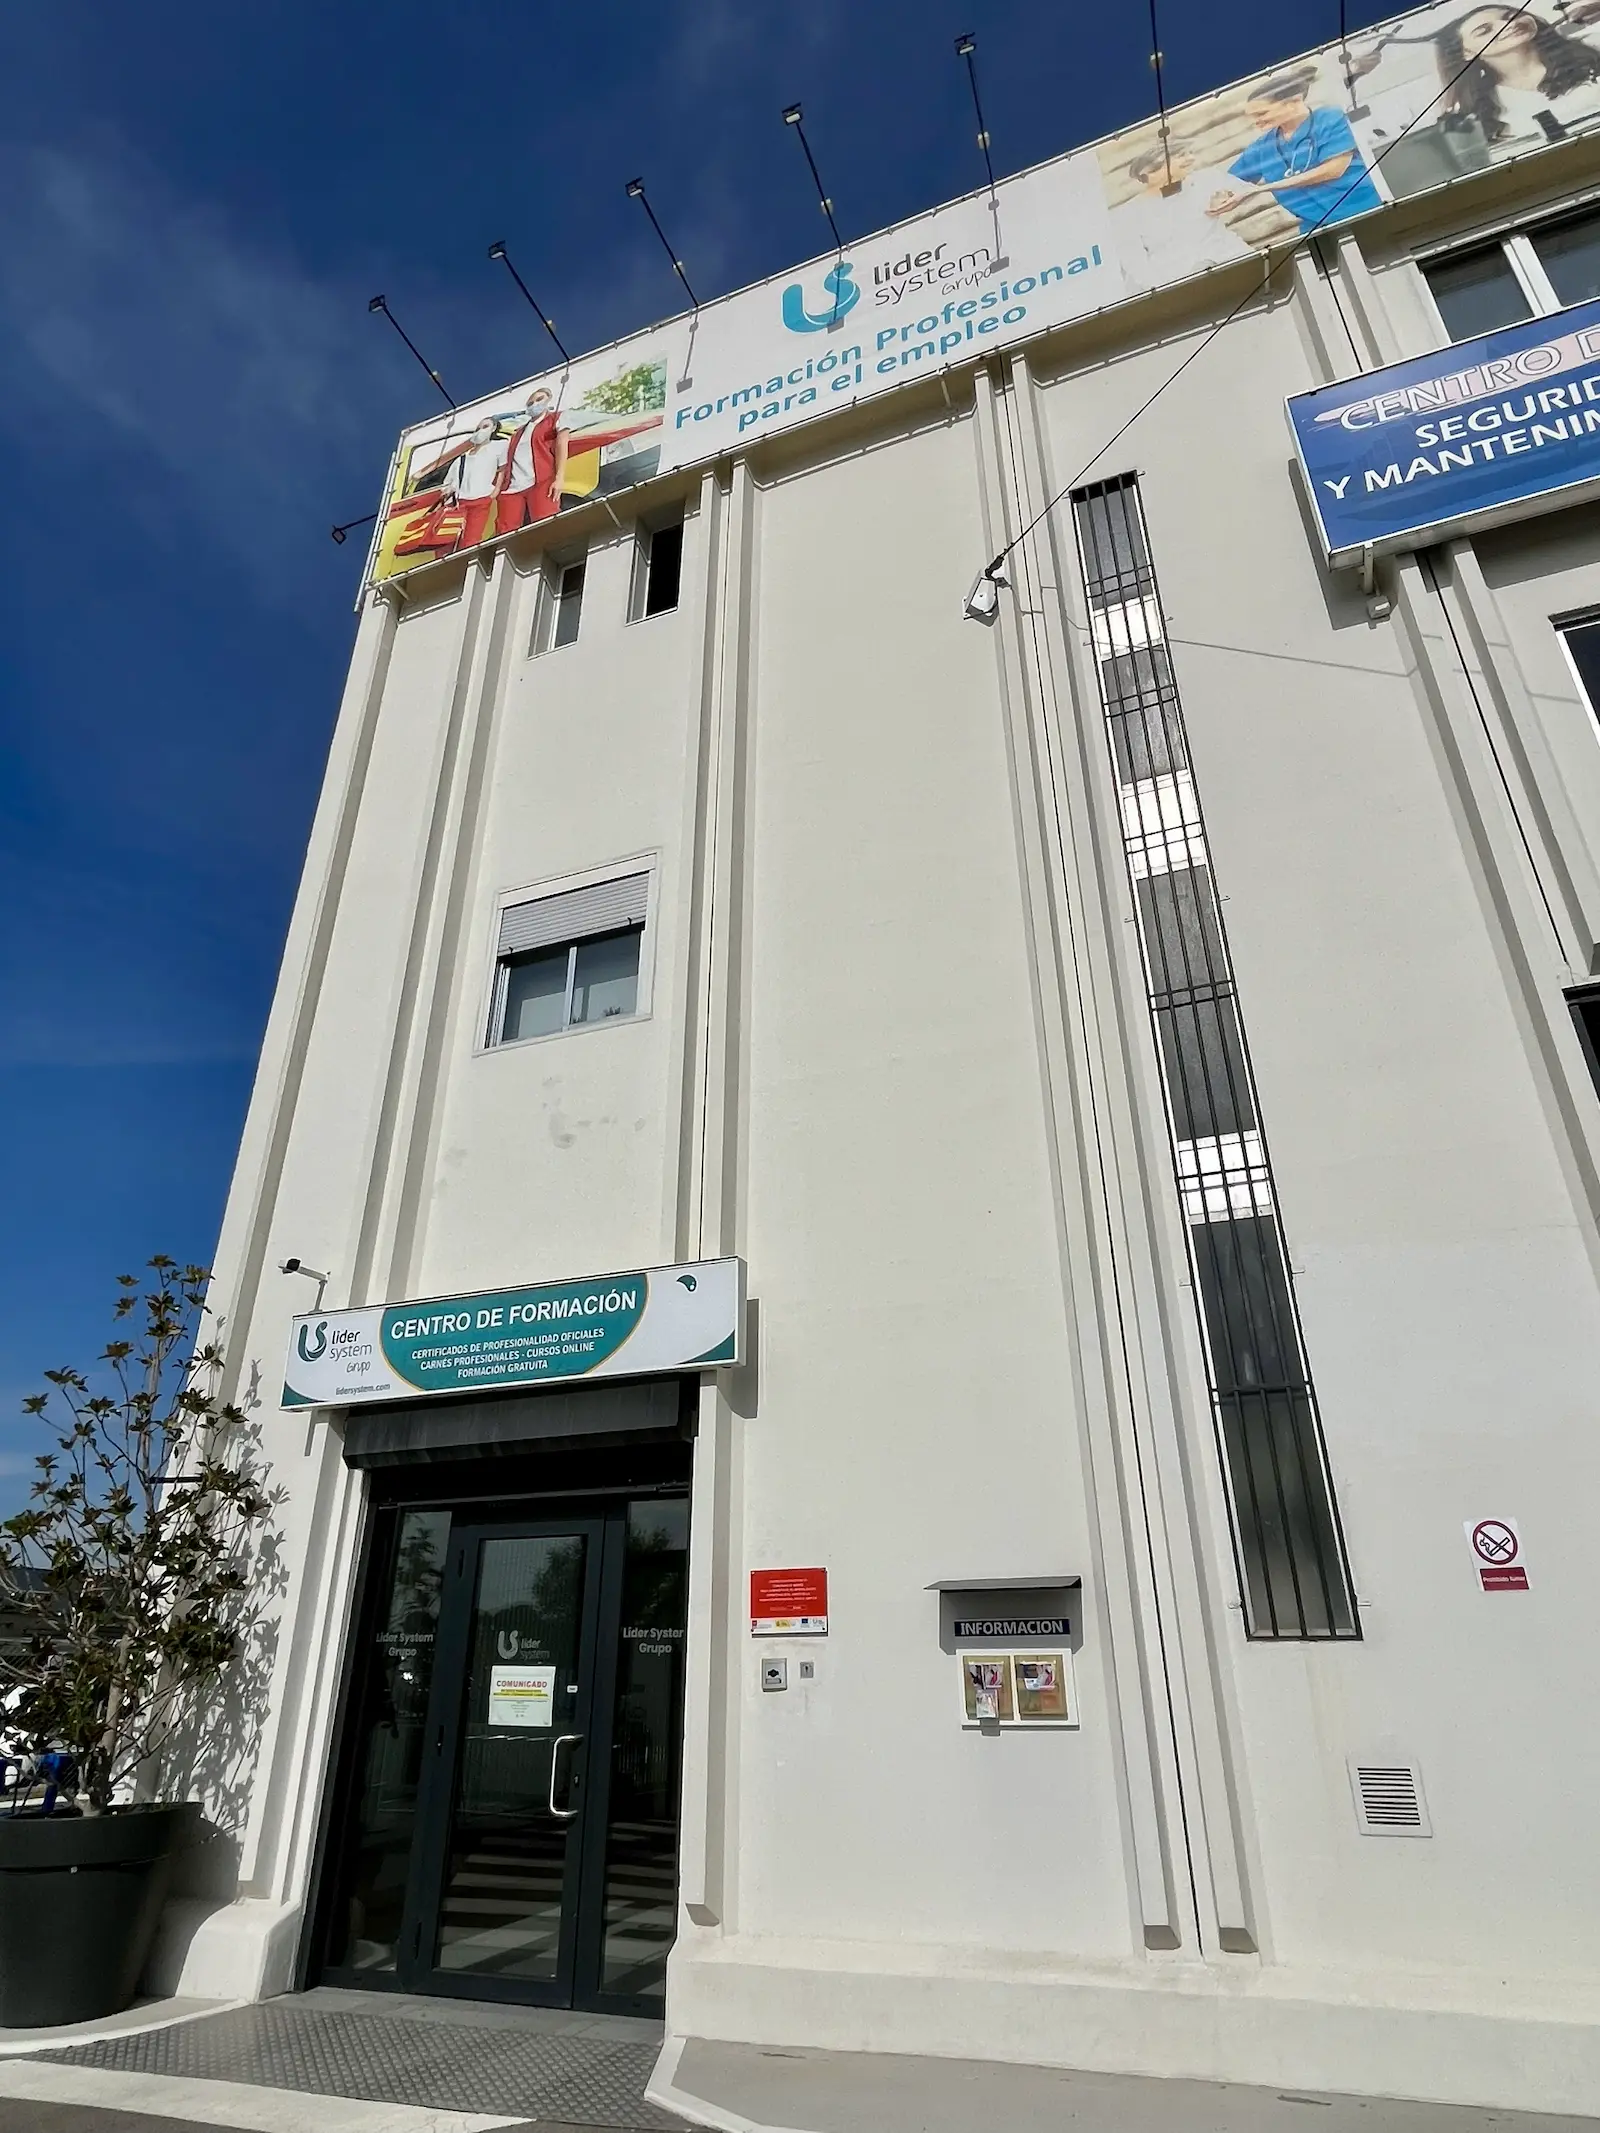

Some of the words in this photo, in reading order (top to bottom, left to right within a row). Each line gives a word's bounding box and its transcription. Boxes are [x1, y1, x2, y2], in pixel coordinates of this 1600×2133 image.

[873, 242, 947, 285] lider
[875, 248, 990, 306] system
[676, 345, 862, 429] Formación
[877, 245, 1102, 350] Profesional
[739, 387, 817, 432] para
[831, 364, 862, 391] el
[877, 305, 1026, 374] empleo
[1340, 346, 1561, 430] CENTRO
[1324, 475, 1351, 499] Y
[391, 1312, 472, 1340] CENTRO
[476, 1307, 504, 1329] DE
[509, 1288, 637, 1325] FORMACIÓN
[332, 1330, 360, 1344] lider
[411, 1344, 468, 1359] CERTIFICADOS
[470, 1342, 481, 1353] DE
[483, 1334, 559, 1351] PROFESIONALIDAD
[560, 1327, 605, 1341] OFICIALES
[330, 1344, 372, 1362] system
[420, 1357, 452, 1370] CARNÉS
[454, 1351, 520, 1366] PROFESIONALES
[526, 1345, 560, 1358] CURSOS
[562, 1341, 595, 1354] ONLINE
[346, 1361, 371, 1376] Grupo
[457, 1364, 506, 1378] FORMACIÓN
[507, 1359, 548, 1373] GRATUITA
[335, 1383, 391, 1396] lidersystem.com
[960, 1620, 1064, 1635] INFORMACION
[399, 1632, 434, 1646] System
[521, 1638, 541, 1649] lider
[388, 1647, 418, 1660] Grupo
[519, 1650, 551, 1661] system
[638, 1643, 672, 1657] Grupo
[496, 1680, 548, 1688] COMUNICADO
